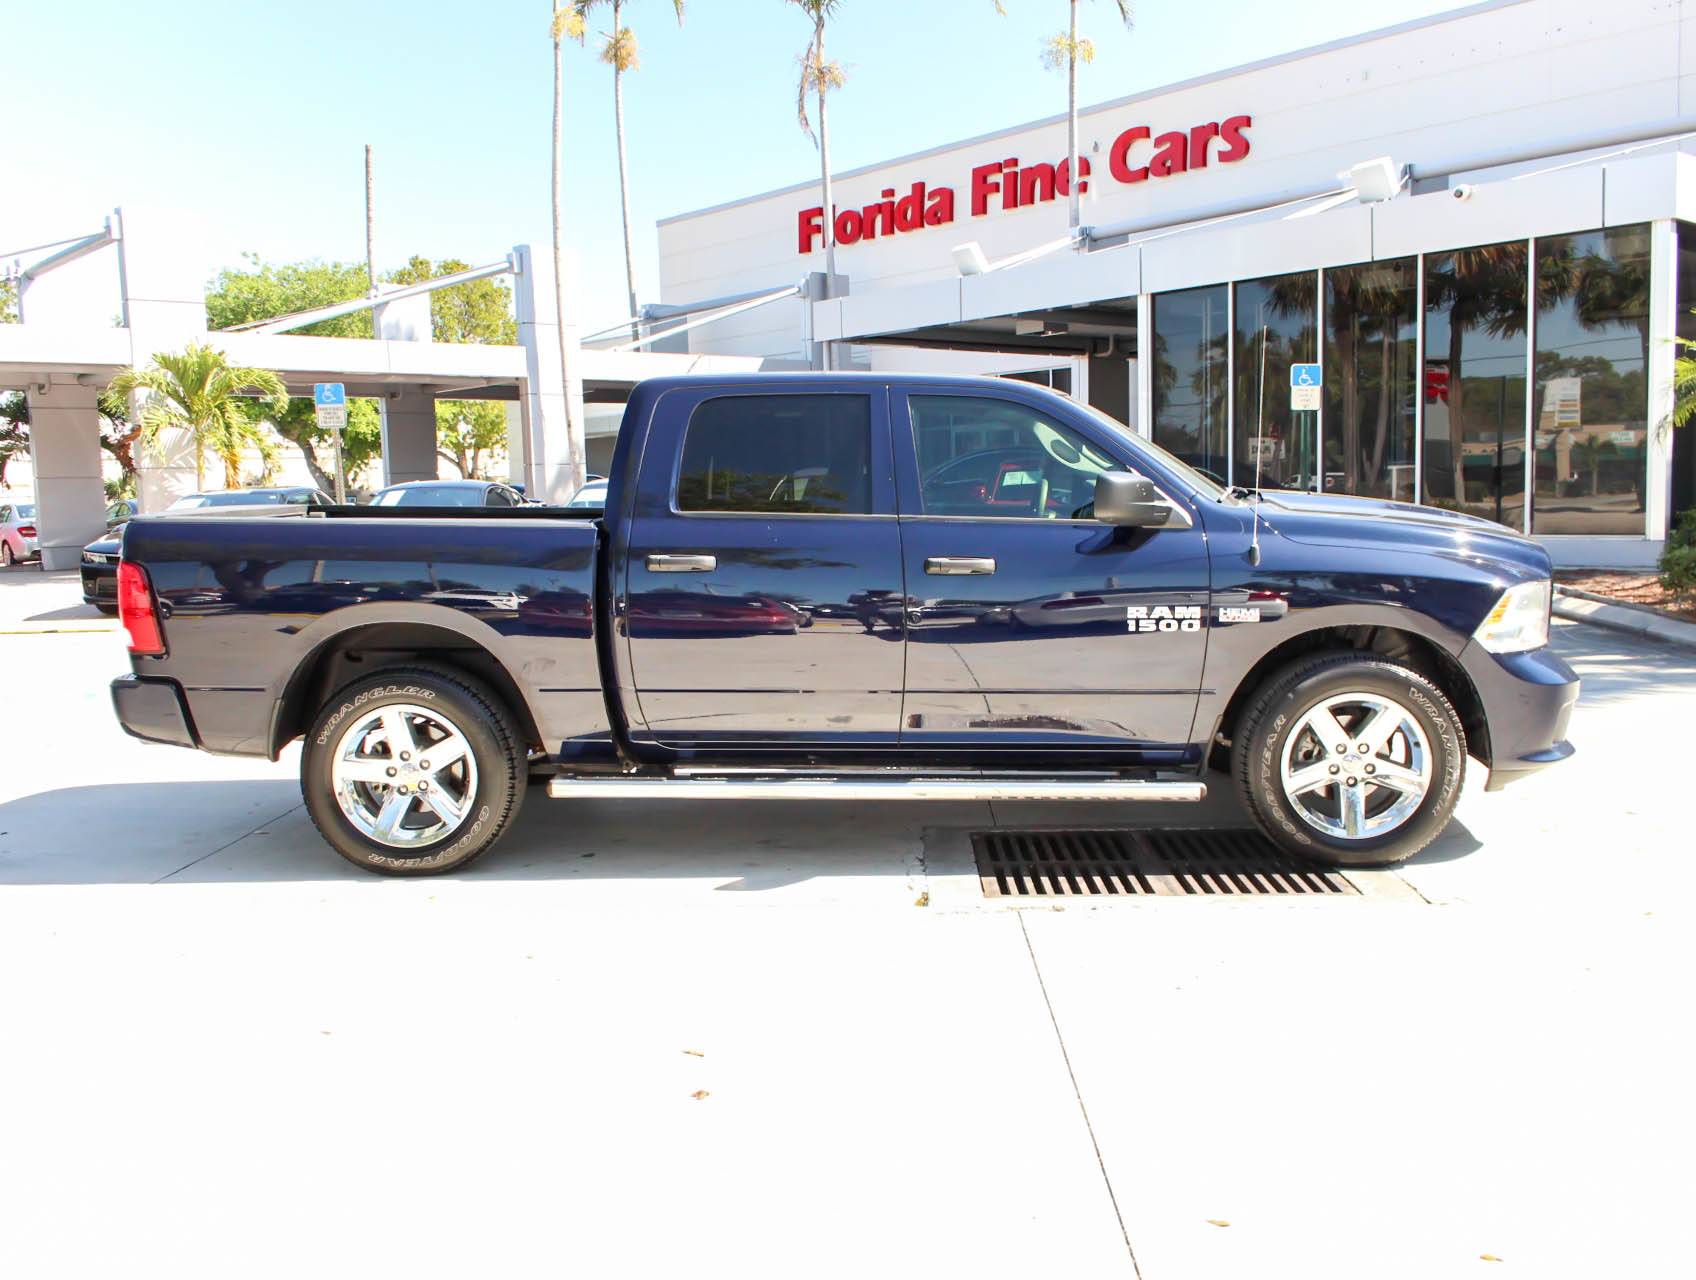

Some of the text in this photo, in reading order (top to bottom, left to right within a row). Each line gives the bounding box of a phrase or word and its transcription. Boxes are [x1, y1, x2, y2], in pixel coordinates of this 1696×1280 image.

[971, 157, 1092, 217] Fine
[1109, 115, 1252, 184] Cars
[1127, 606, 1201, 618] RAM
[1127, 619, 1201, 632] 1500
[1219, 607, 1260, 617] HEMI
[317, 685, 436, 744] WRANGLER
[1261, 713, 1312, 845] GOODYEAR
[368, 805, 490, 867] GOODYEAR
